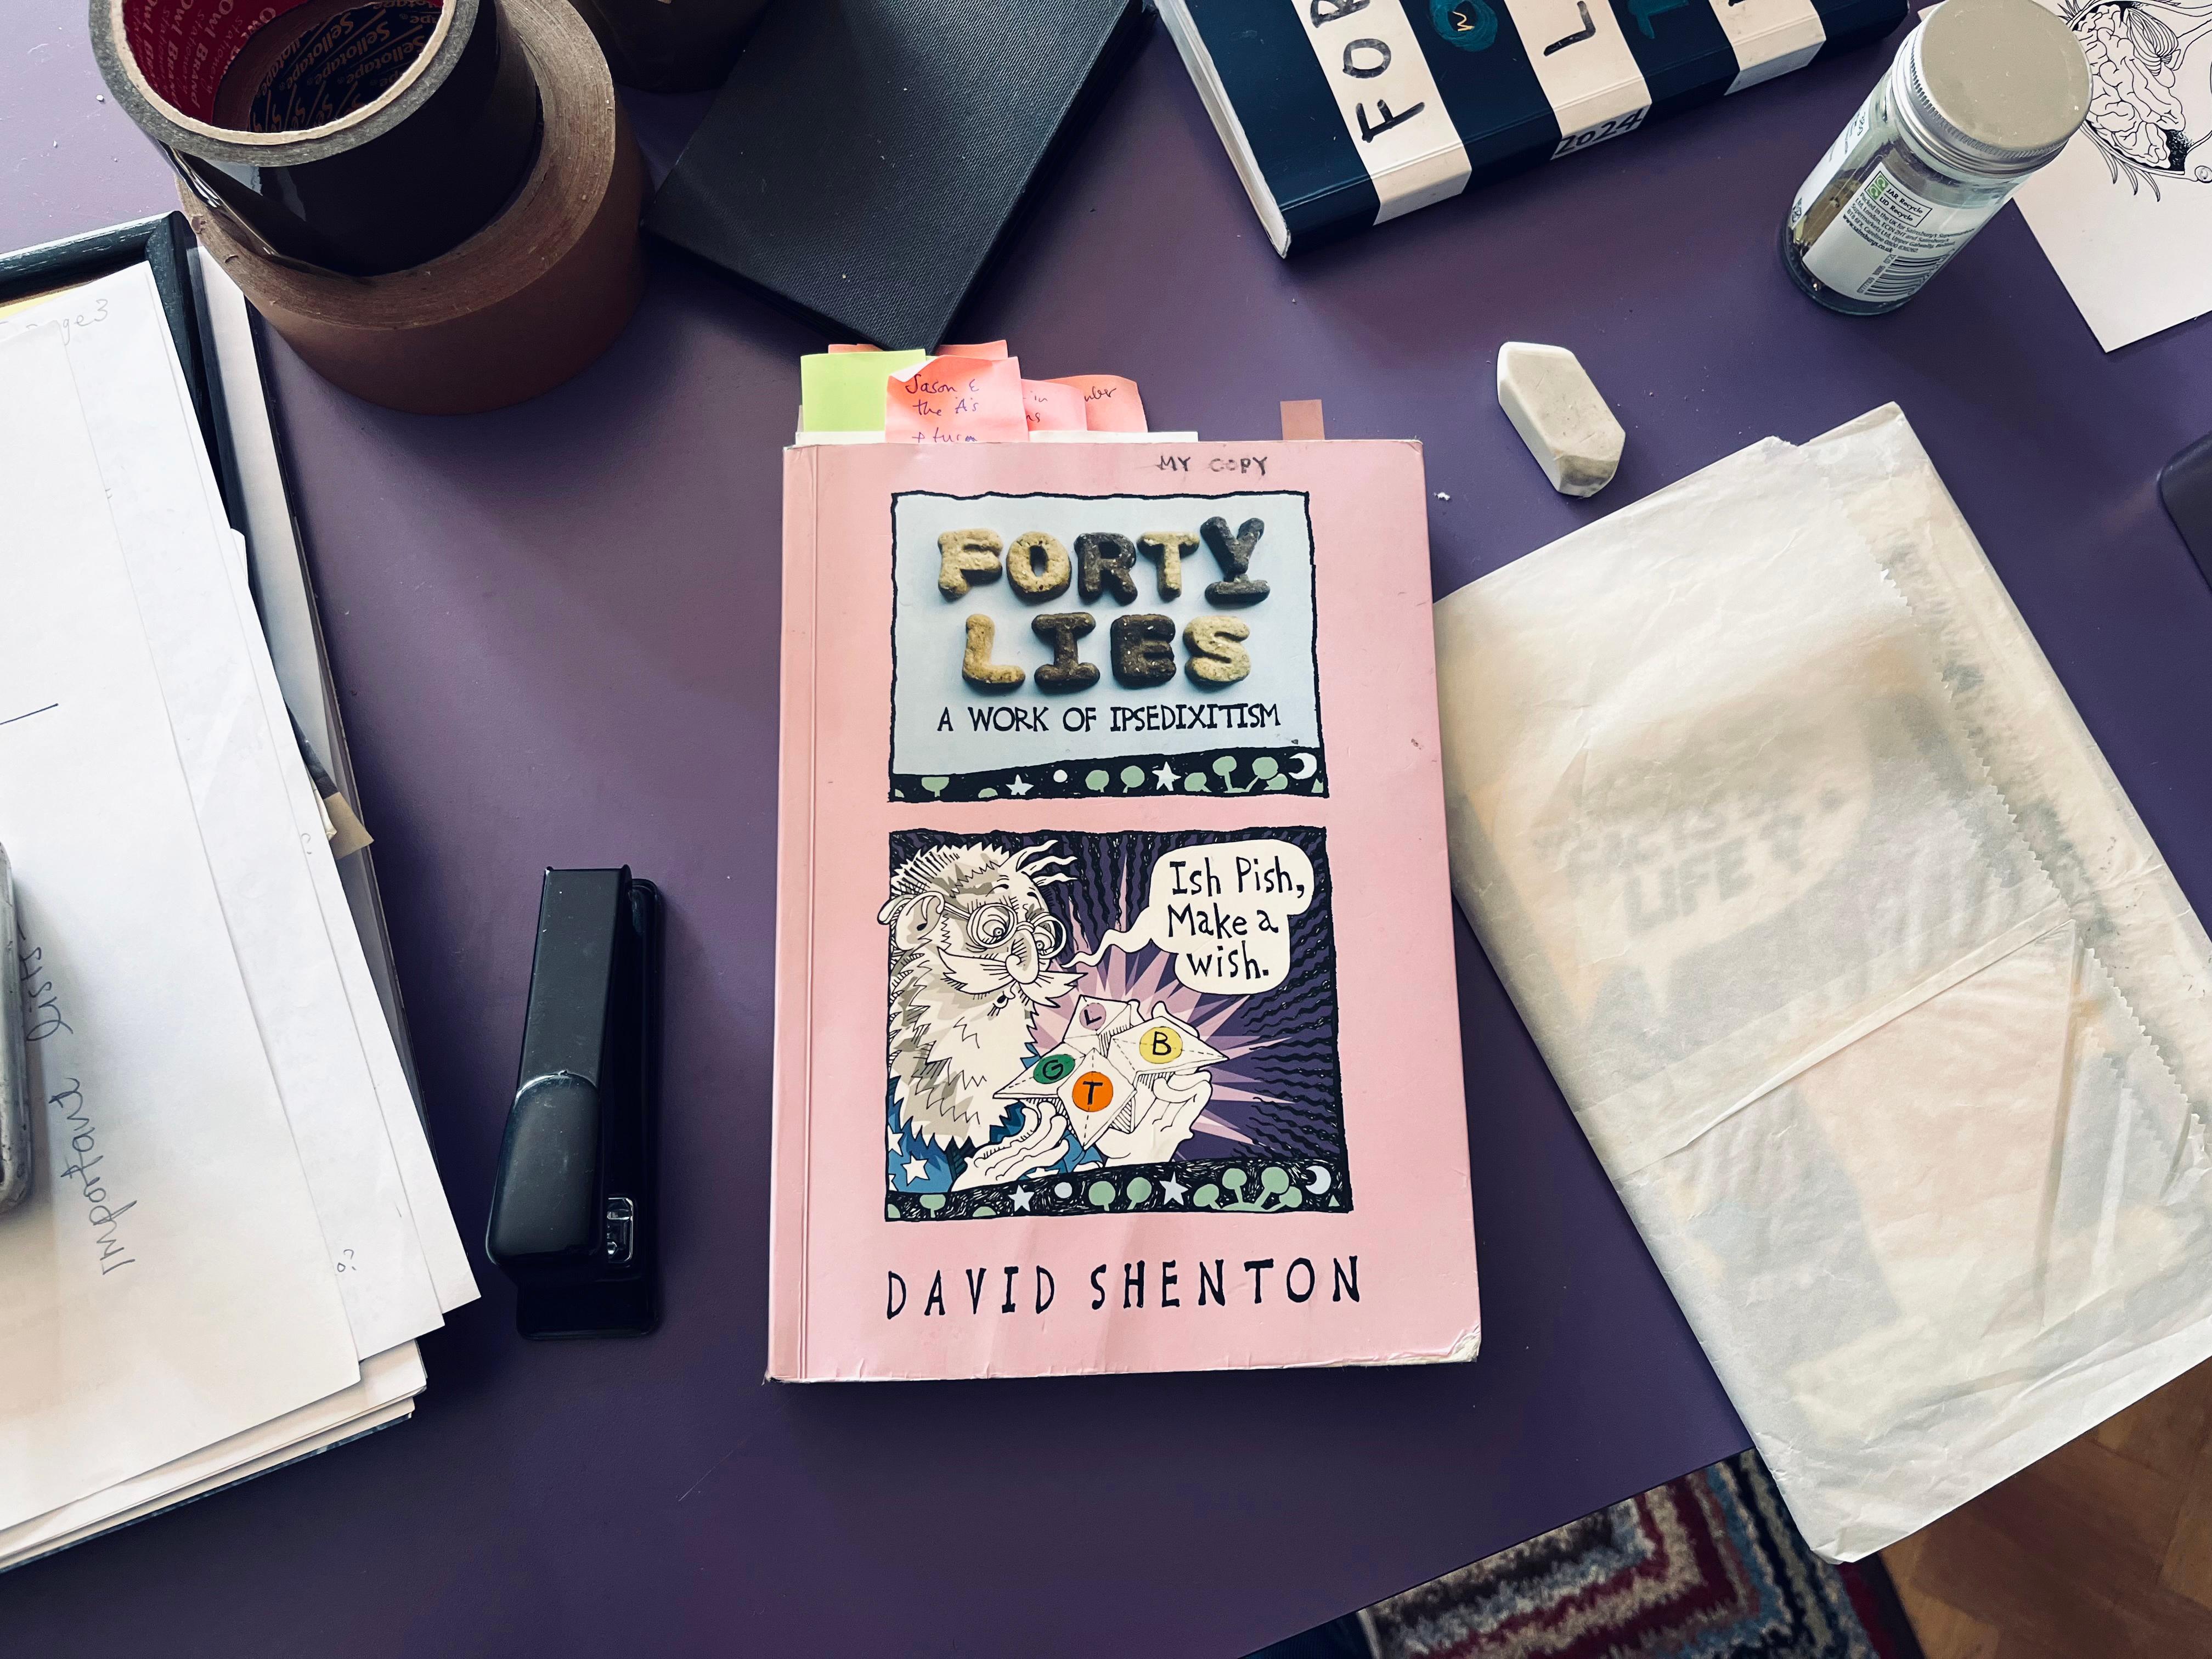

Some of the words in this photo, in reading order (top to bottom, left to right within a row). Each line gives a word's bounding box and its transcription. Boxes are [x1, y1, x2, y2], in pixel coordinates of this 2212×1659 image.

[1554, 108, 1645, 156] 2024
[1886, 188, 1899, 200] JAR
[1899, 198, 1923, 214] Recycle
[1890, 205, 1913, 221] Recycle
[1880, 212, 1889, 221] the
[905, 374, 958, 394] Jason
[912, 399, 942, 416] the
[1156, 455, 1191, 472] MY
[1209, 456, 1268, 477] COPY
[937, 516, 1271, 607] FORTY
[962, 611, 1252, 695] LIES
[937, 707, 955, 732] A
[967, 706, 1049, 732] WORK
[1062, 706, 1097, 732] OF
[1109, 702, 1282, 732] IPSEDIXITISM
[1169, 856, 1221, 897] Ish
[1235, 855, 1305, 899] Pish,
[1167, 902, 1248, 939] Make
[1256, 909, 1279, 934] a
[1084, 1009, 1102, 1026] L
[1152, 1031, 1172, 1056] B
[1043, 1059, 1065, 1080] G
[1082, 1081, 1104, 1105] T
[49, 1077, 137, 1276] Important
[886, 1265, 1056, 1319] DAVID
[1091, 1255, 1361, 1311] SHENTON
